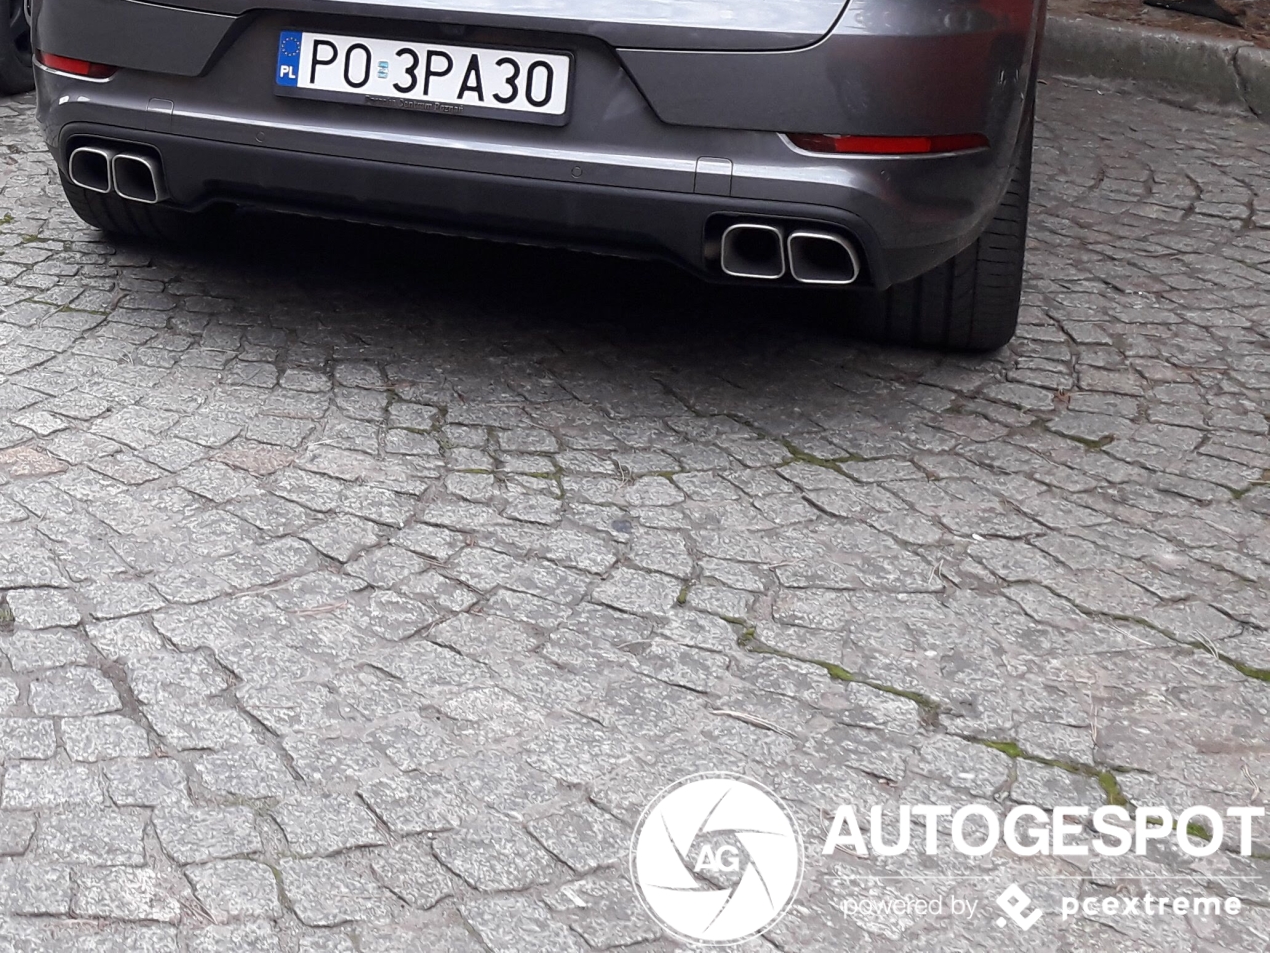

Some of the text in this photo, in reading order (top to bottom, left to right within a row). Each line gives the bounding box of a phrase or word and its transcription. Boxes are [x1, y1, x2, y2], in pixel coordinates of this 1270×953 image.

[279, 38, 555, 108] PL PO 3PA30
